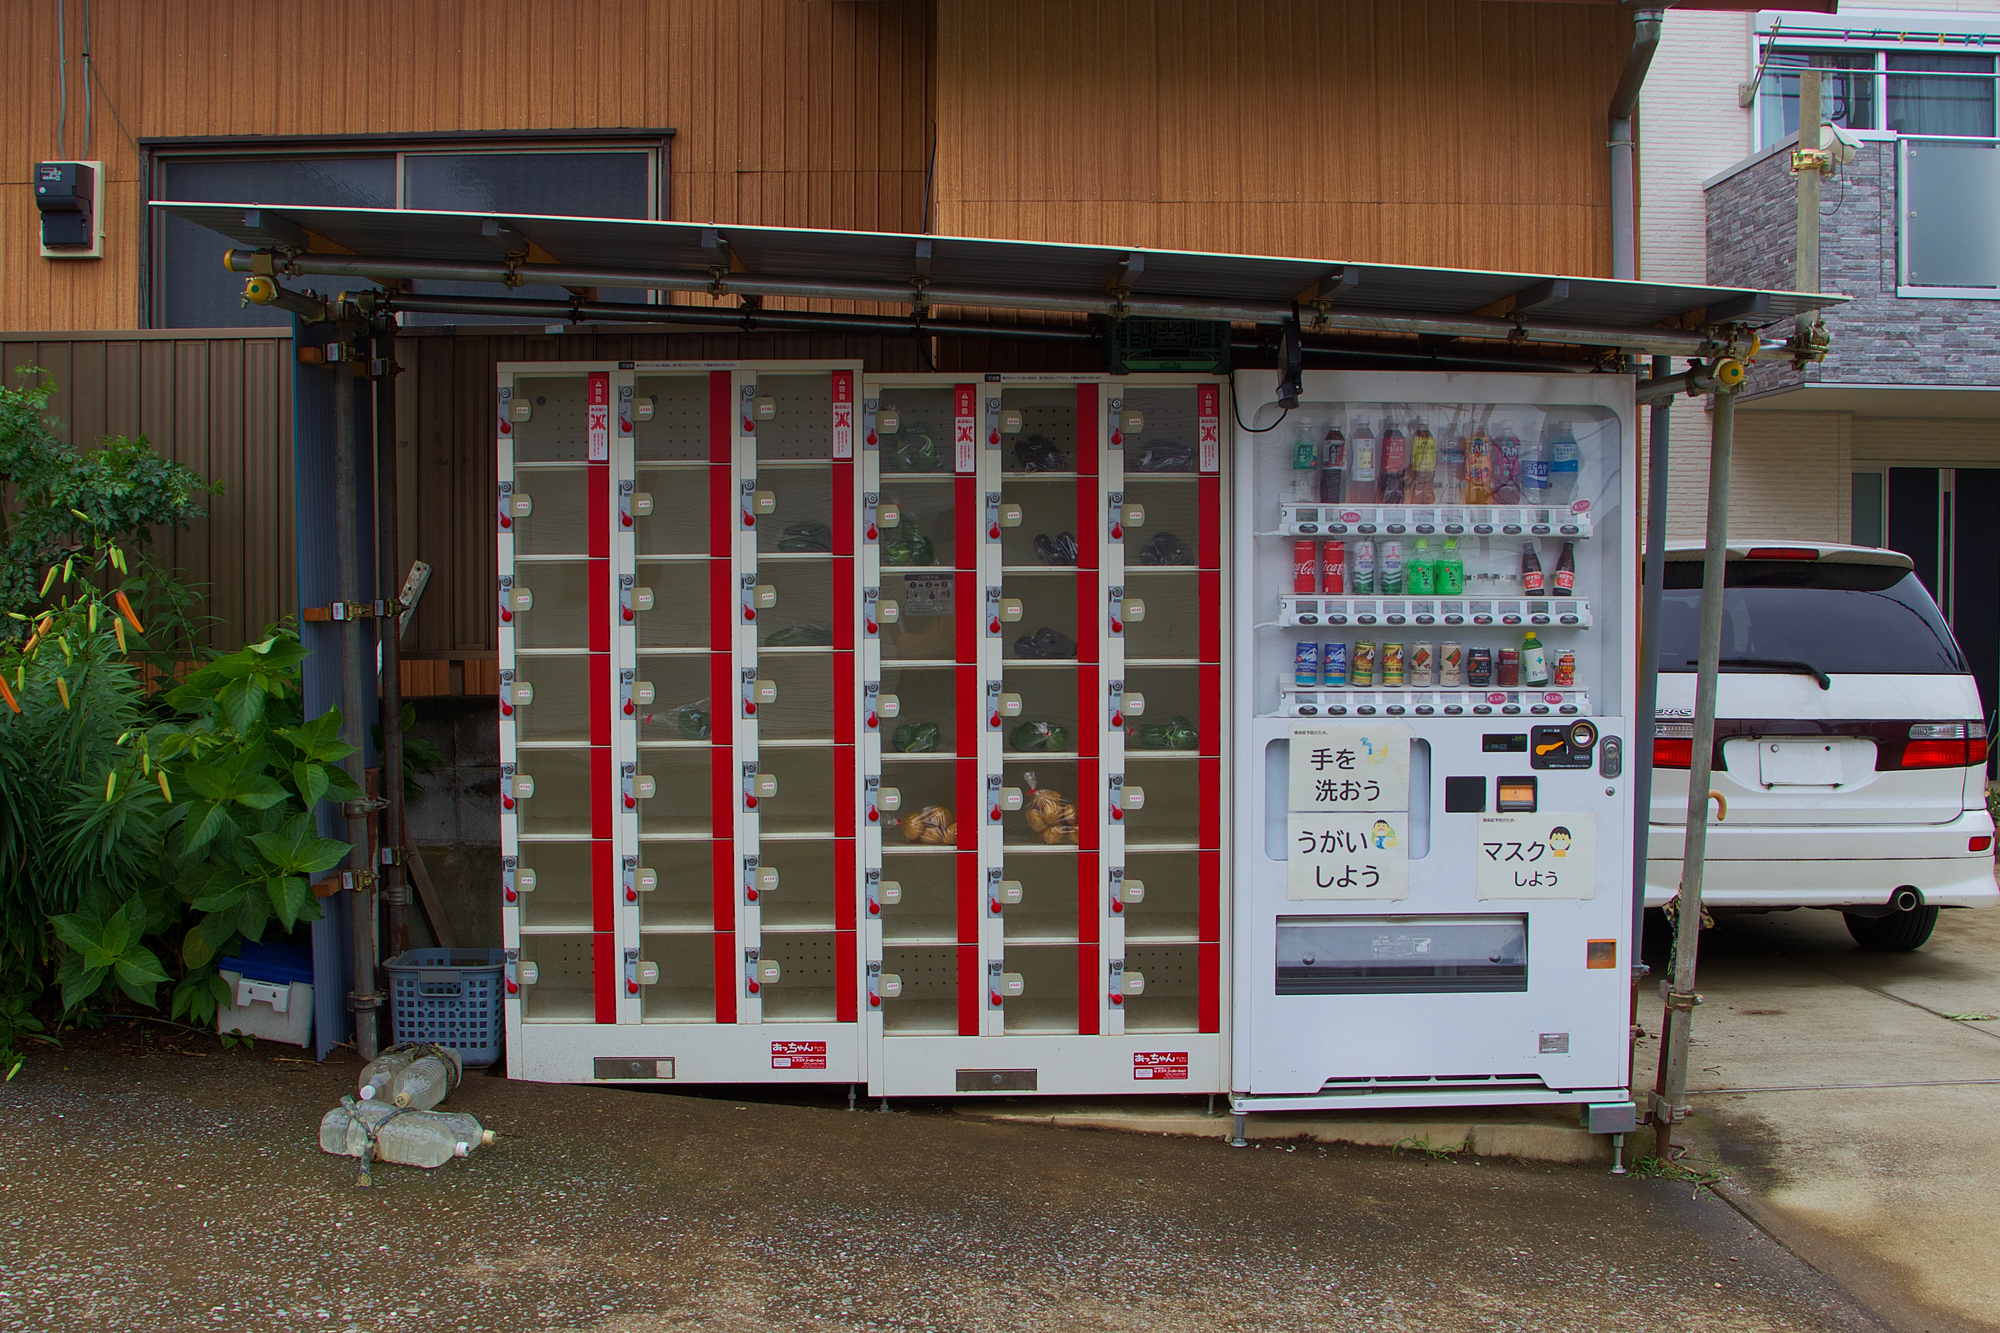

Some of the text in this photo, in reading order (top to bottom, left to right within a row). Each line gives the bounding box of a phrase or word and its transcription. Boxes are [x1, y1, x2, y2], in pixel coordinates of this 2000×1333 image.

[1654, 708, 1691, 716] ERAS
[1311, 748, 1356, 771] 手を
[1315, 778, 1380, 802] 洗おう
[1298, 829, 1368, 854] うがい
[1483, 841, 1546, 863] マスク
[1316, 864, 1380, 888] しよう
[1514, 870, 1558, 887] しよう
[772, 1042, 814, 1054] あっちゃん
[1134, 1053, 1175, 1065] あっちゃん
